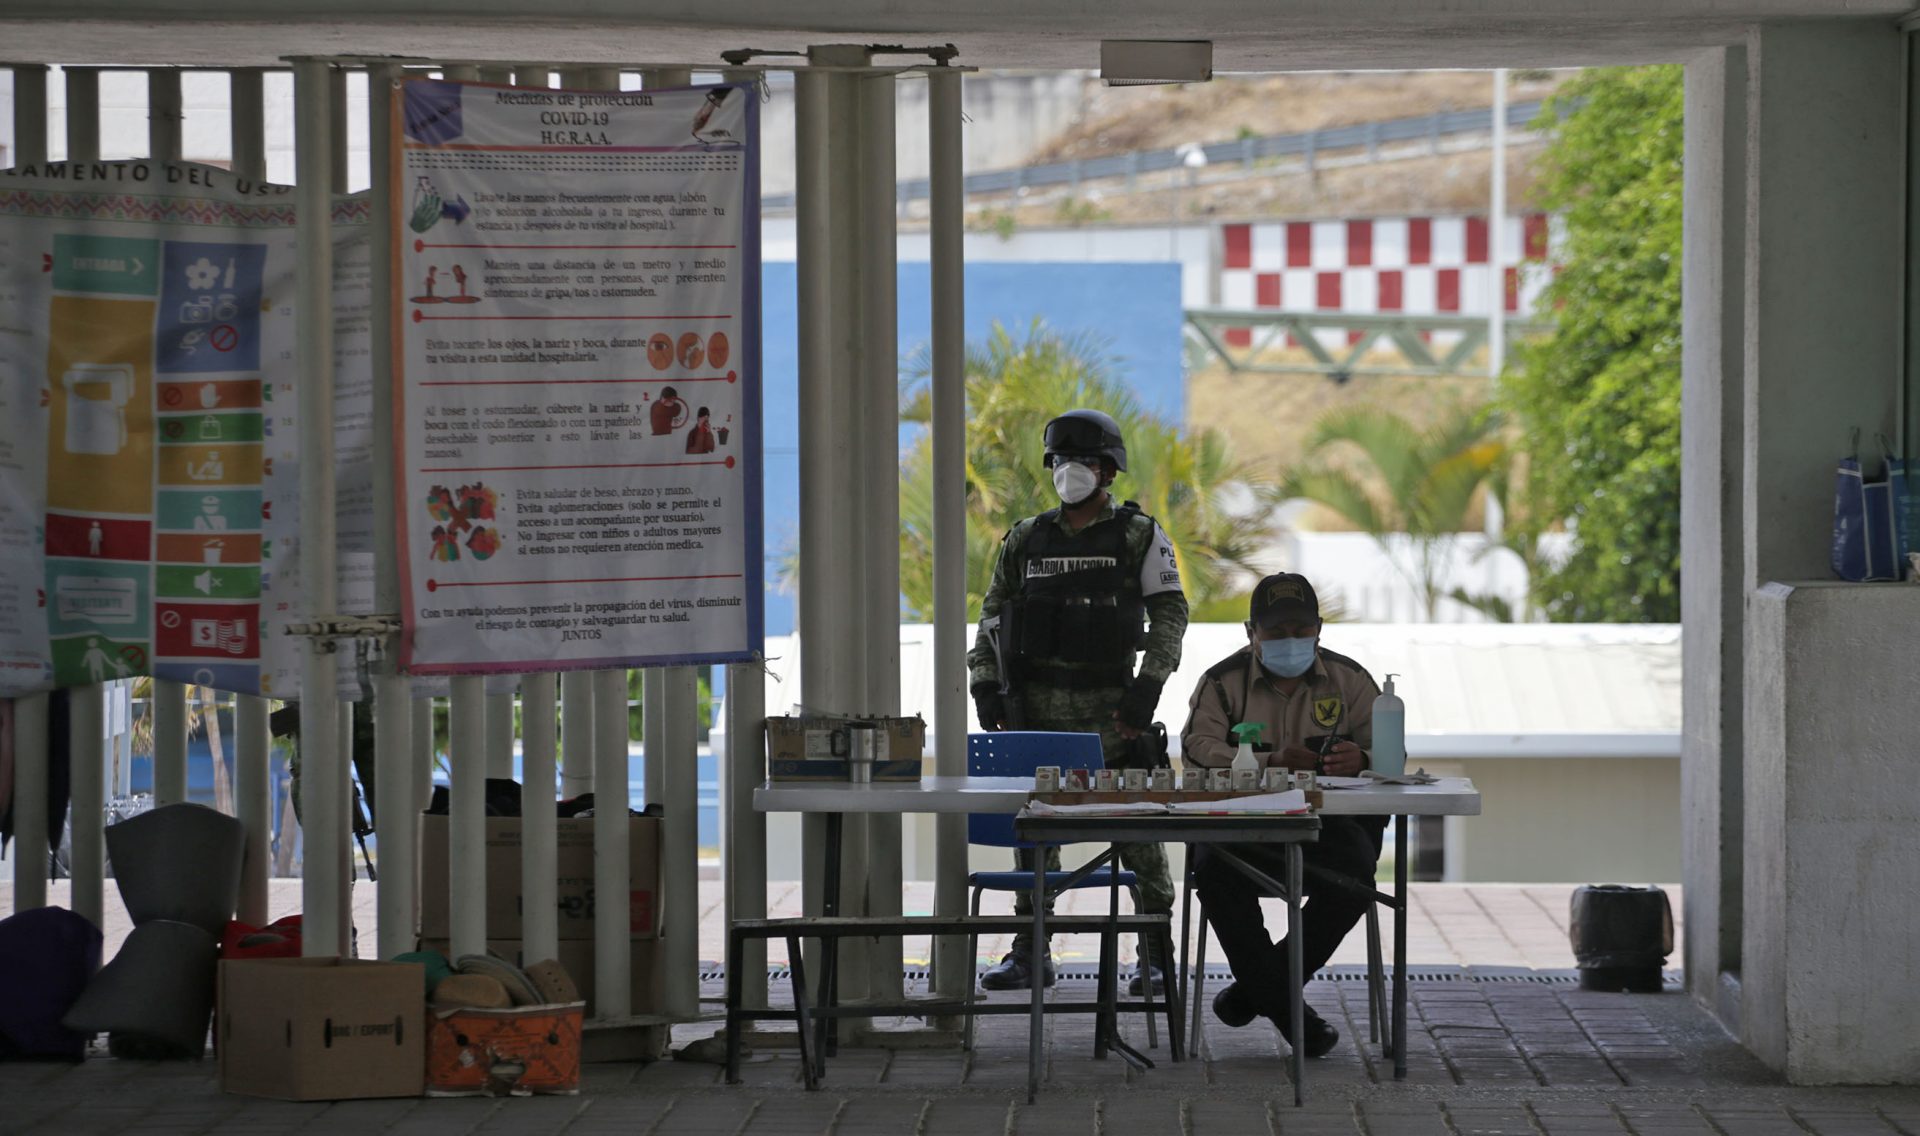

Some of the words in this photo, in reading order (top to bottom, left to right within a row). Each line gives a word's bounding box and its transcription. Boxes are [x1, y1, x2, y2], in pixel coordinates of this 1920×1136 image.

[496, 92, 554, 106] Medidas
[558, 93, 574, 106] de
[541, 111, 609, 126] COVID-19
[541, 131, 612, 146] H.G.R.A.A.
[167, 166, 215, 188] DEL
[679, 191, 708, 204] jabón
[669, 205, 708, 216] durante
[714, 206, 725, 216] tu
[564, 220, 576, 230] de
[592, 220, 616, 230] visita
[630, 219, 668, 232] hospital
[553, 259, 596, 270] distancia
[604, 258, 616, 270] de
[623, 261, 636, 270] un
[642, 260, 672, 270] metro
[679, 261, 686, 271] y
[695, 258, 727, 269] medio
[576, 275, 595, 284] con
[651, 275, 670, 286] que
[676, 273, 726, 285] presenten
[531, 287, 543, 298] de
[592, 289, 599, 297] o
[601, 287, 657, 298] estornuden.
[488, 338, 502, 349] los
[504, 338, 530, 351] ojos,
[533, 338, 542, 349] la
[544, 338, 570, 348] nariz
[573, 339, 580, 350] y
[583, 337, 608, 348] boca,
[610, 336, 646, 348] durante
[470, 355, 476, 364] a
[539, 352, 599, 364] hospitalaria.
[472, 407, 480, 416] o
[546, 403, 583, 414] cúbrete
[589, 402, 598, 413] la
[604, 402, 630, 414] nariz
[636, 403, 643, 414] y
[560, 419, 568, 428] o
[569, 418, 586, 428] con
[589, 418, 602, 428] un
[604, 415, 642, 429] pañuelo
[545, 434, 552, 442] a
[560, 432, 581, 442] esto
[590, 430, 620, 441] lávate
[629, 429, 642, 440] las
[516, 488, 542, 500] Evita
[544, 487, 578, 499] saludar
[580, 487, 592, 498] de
[594, 487, 620, 498] beso,
[622, 486, 654, 497] abrazo
[656, 488, 664, 498] y
[665, 486, 694, 496] mano.
[517, 503, 544, 514] Evita
[548, 501, 624, 515] aglomeraciones
[628, 499, 652, 512] (solo
[656, 502, 668, 510] se
[672, 497, 710, 512] permite
[713, 497, 722, 508] el
[517, 518, 552, 528] acceso
[553, 518, 560, 527] a
[561, 517, 574, 526] un
[576, 513, 642, 528] acompañante
[643, 515, 660, 526] por
[518, 531, 533, 542] No
[536, 529, 577, 543] ingresar
[579, 530, 598, 540] con
[602, 528, 630, 539] niños
[633, 529, 640, 538] o
[643, 526, 679, 538] adultos
[683, 526, 722, 538] mayores
[518, 544, 528, 556] si
[529, 545, 556, 555] estos
[558, 545, 570, 554] no
[572, 542, 622, 556] requieren
[623, 540, 664, 552] atención
[1029, 559, 1064, 576] GUARDIA
[421, 607, 442, 619] Con
[443, 608, 454, 618] tu
[456, 606, 484, 618] ayuda
[485, 605, 528, 618] podemos
[529, 603, 572, 616] prevenir
[574, 602, 583, 612] la
[585, 600, 647, 614] propagación
[649, 599, 666, 610] del
[667, 599, 695, 610] virus,
[696, 595, 742, 608] disminuir
[475, 619, 484, 630] el
[485, 620, 514, 632] riesgo
[515, 618, 528, 630] de
[529, 617, 571, 630] contagio
[572, 618, 579, 628] y
[582, 615, 646, 628] salvaguardar
[650, 613, 660, 624] tu
[662, 612, 690, 623] salud.
[562, 629, 602, 642] JUNTOS
